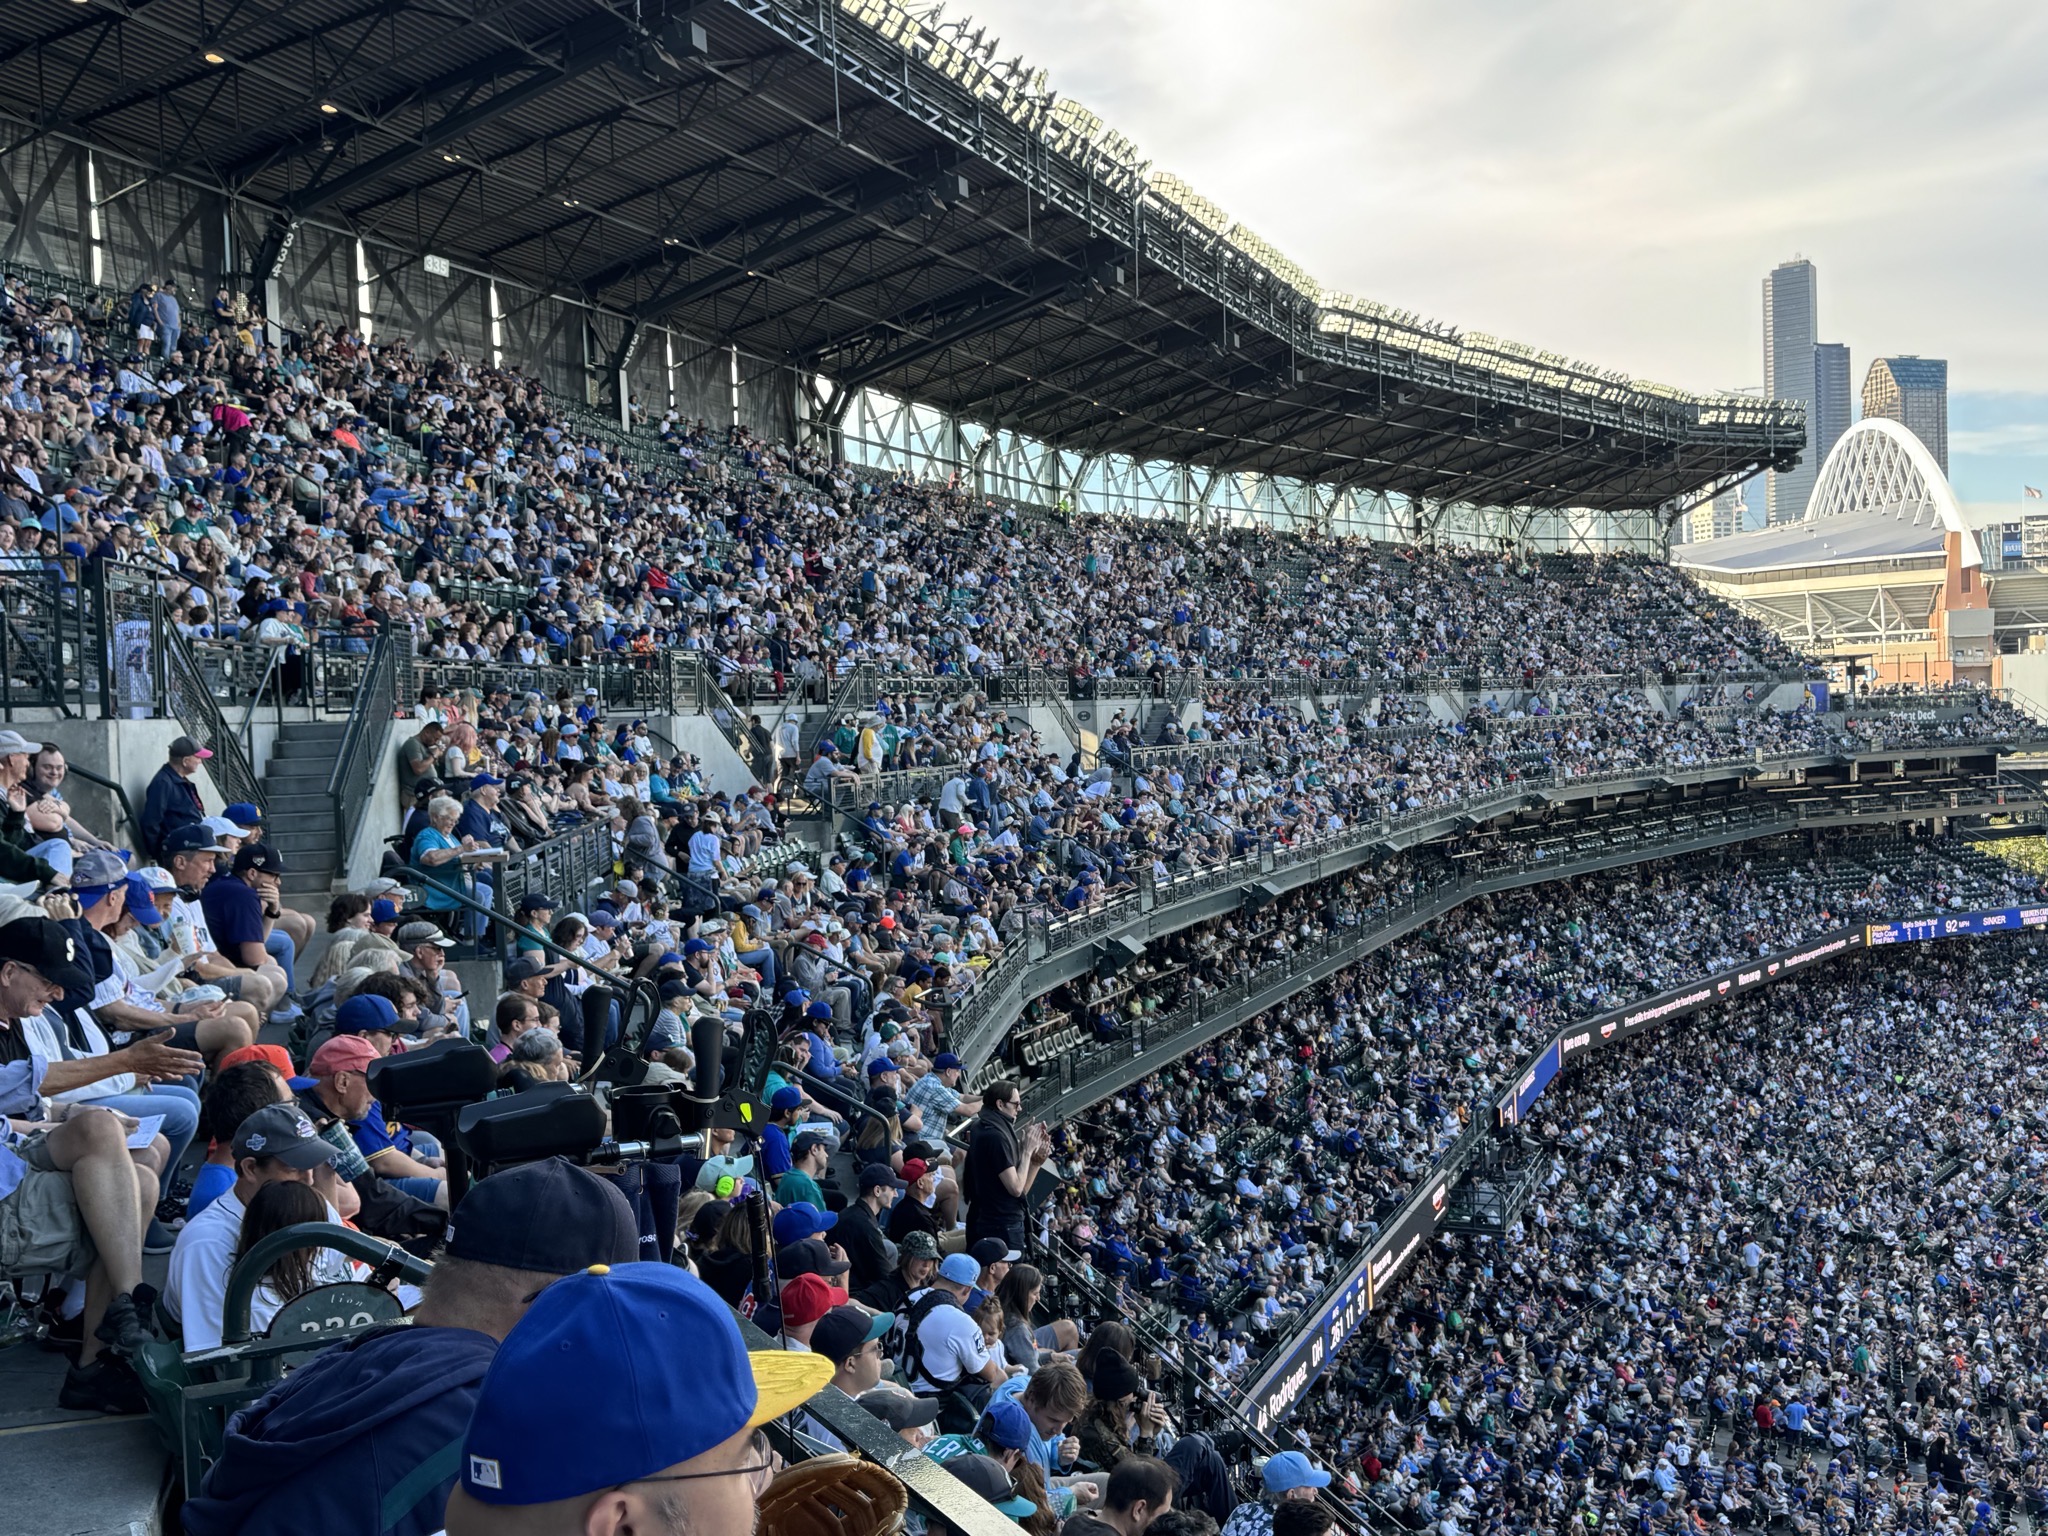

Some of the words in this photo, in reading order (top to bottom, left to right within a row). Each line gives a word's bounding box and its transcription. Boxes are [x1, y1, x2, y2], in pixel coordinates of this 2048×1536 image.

[272, 232, 294, 278] 334
[425, 256, 447, 273] 335
[622, 333, 640, 369] 337
[1917, 709, 1937, 720] Deck
[1927, 918, 1938, 926] Total
[1945, 919, 1958, 933] 92
[1958, 920, 1970, 928] MPH
[1983, 915, 2006, 926] SINKER
[1872, 937, 1883, 945] First
[1883, 935, 1895, 943] Pitch
[1884, 929, 1898, 937] Count
[66, 937, 75, 962] S
[1269, 1361, 1308, 1418] Rodriguez
[1312, 1336, 1323, 1368] DH
[1330, 1316, 1344, 1351] .261
[1346, 1304, 1354, 1329] 11
[1357, 1289, 1366, 1316] 37
